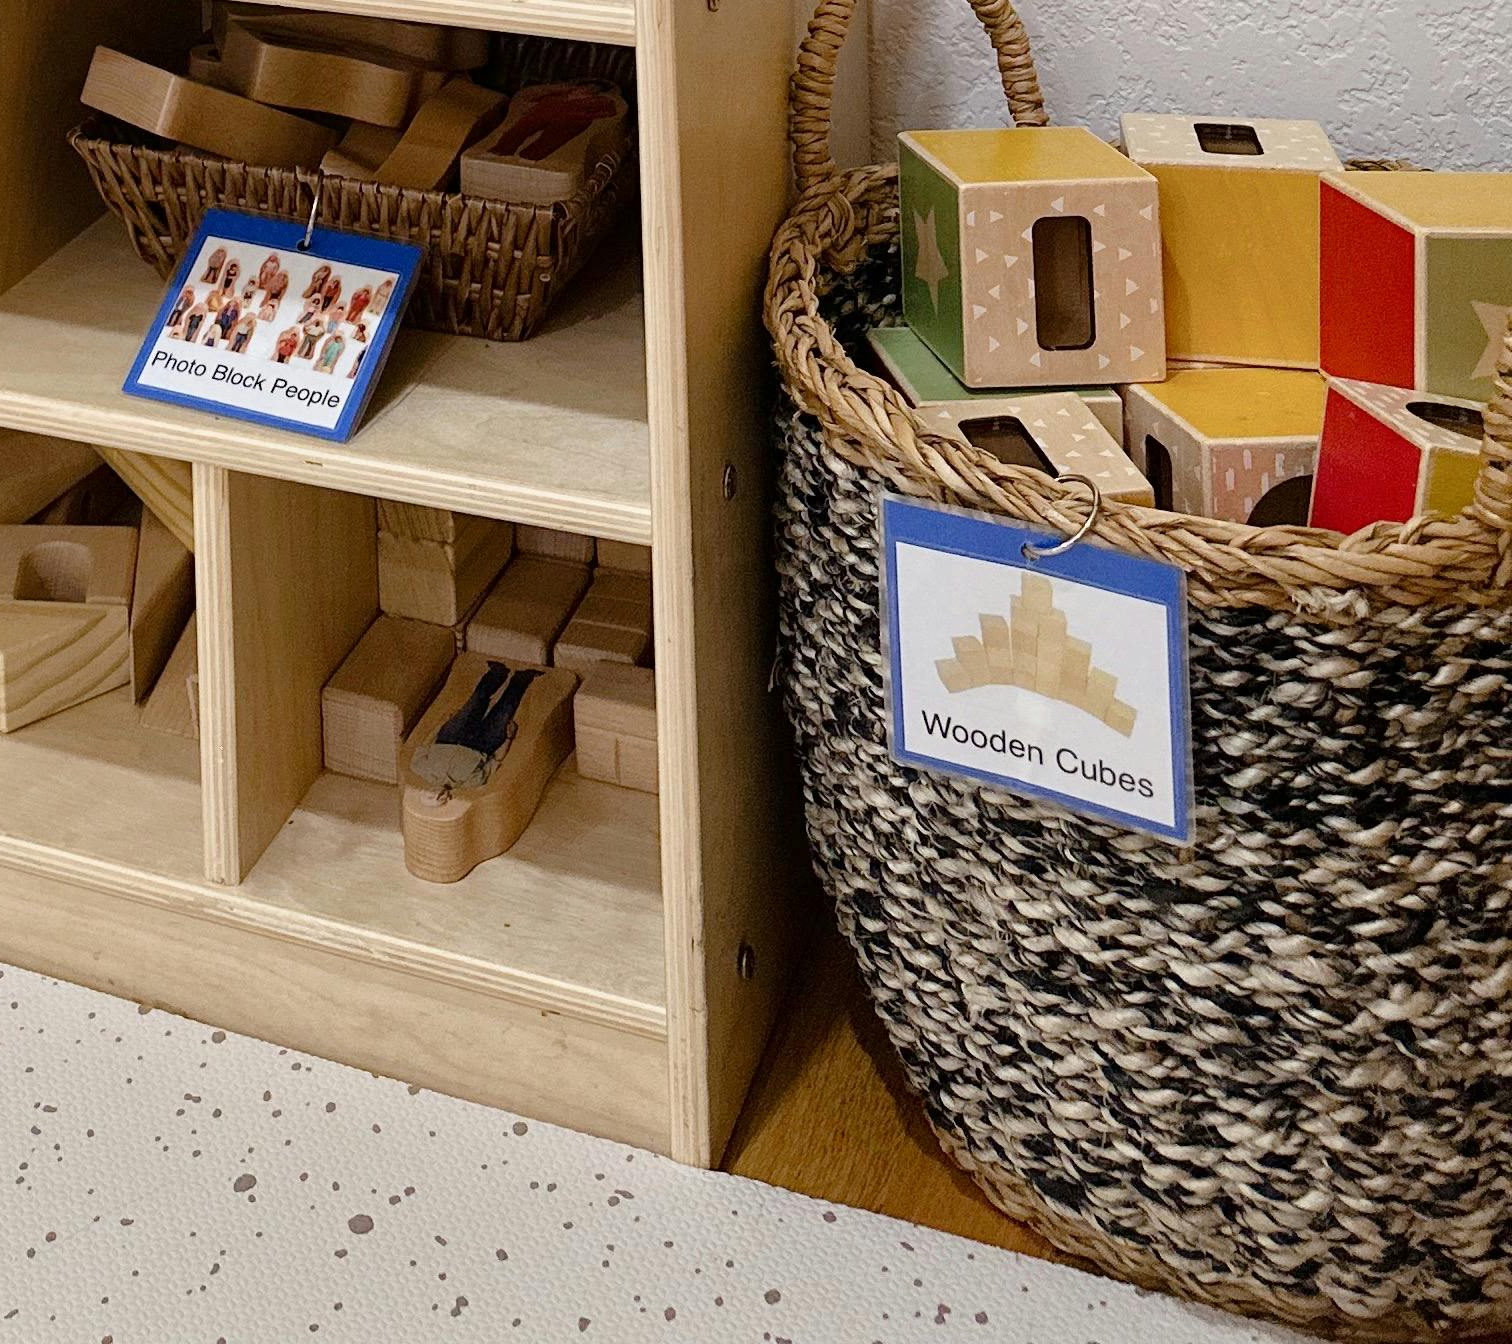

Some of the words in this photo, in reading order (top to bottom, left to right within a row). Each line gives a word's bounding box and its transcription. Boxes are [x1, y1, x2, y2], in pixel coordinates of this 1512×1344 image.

[151, 350, 207, 377] Photo
[211, 364, 264, 392] Block
[270, 378, 340, 408] People
[921, 709, 1044, 766] Wooden
[1055, 747, 1155, 799] Cubes
